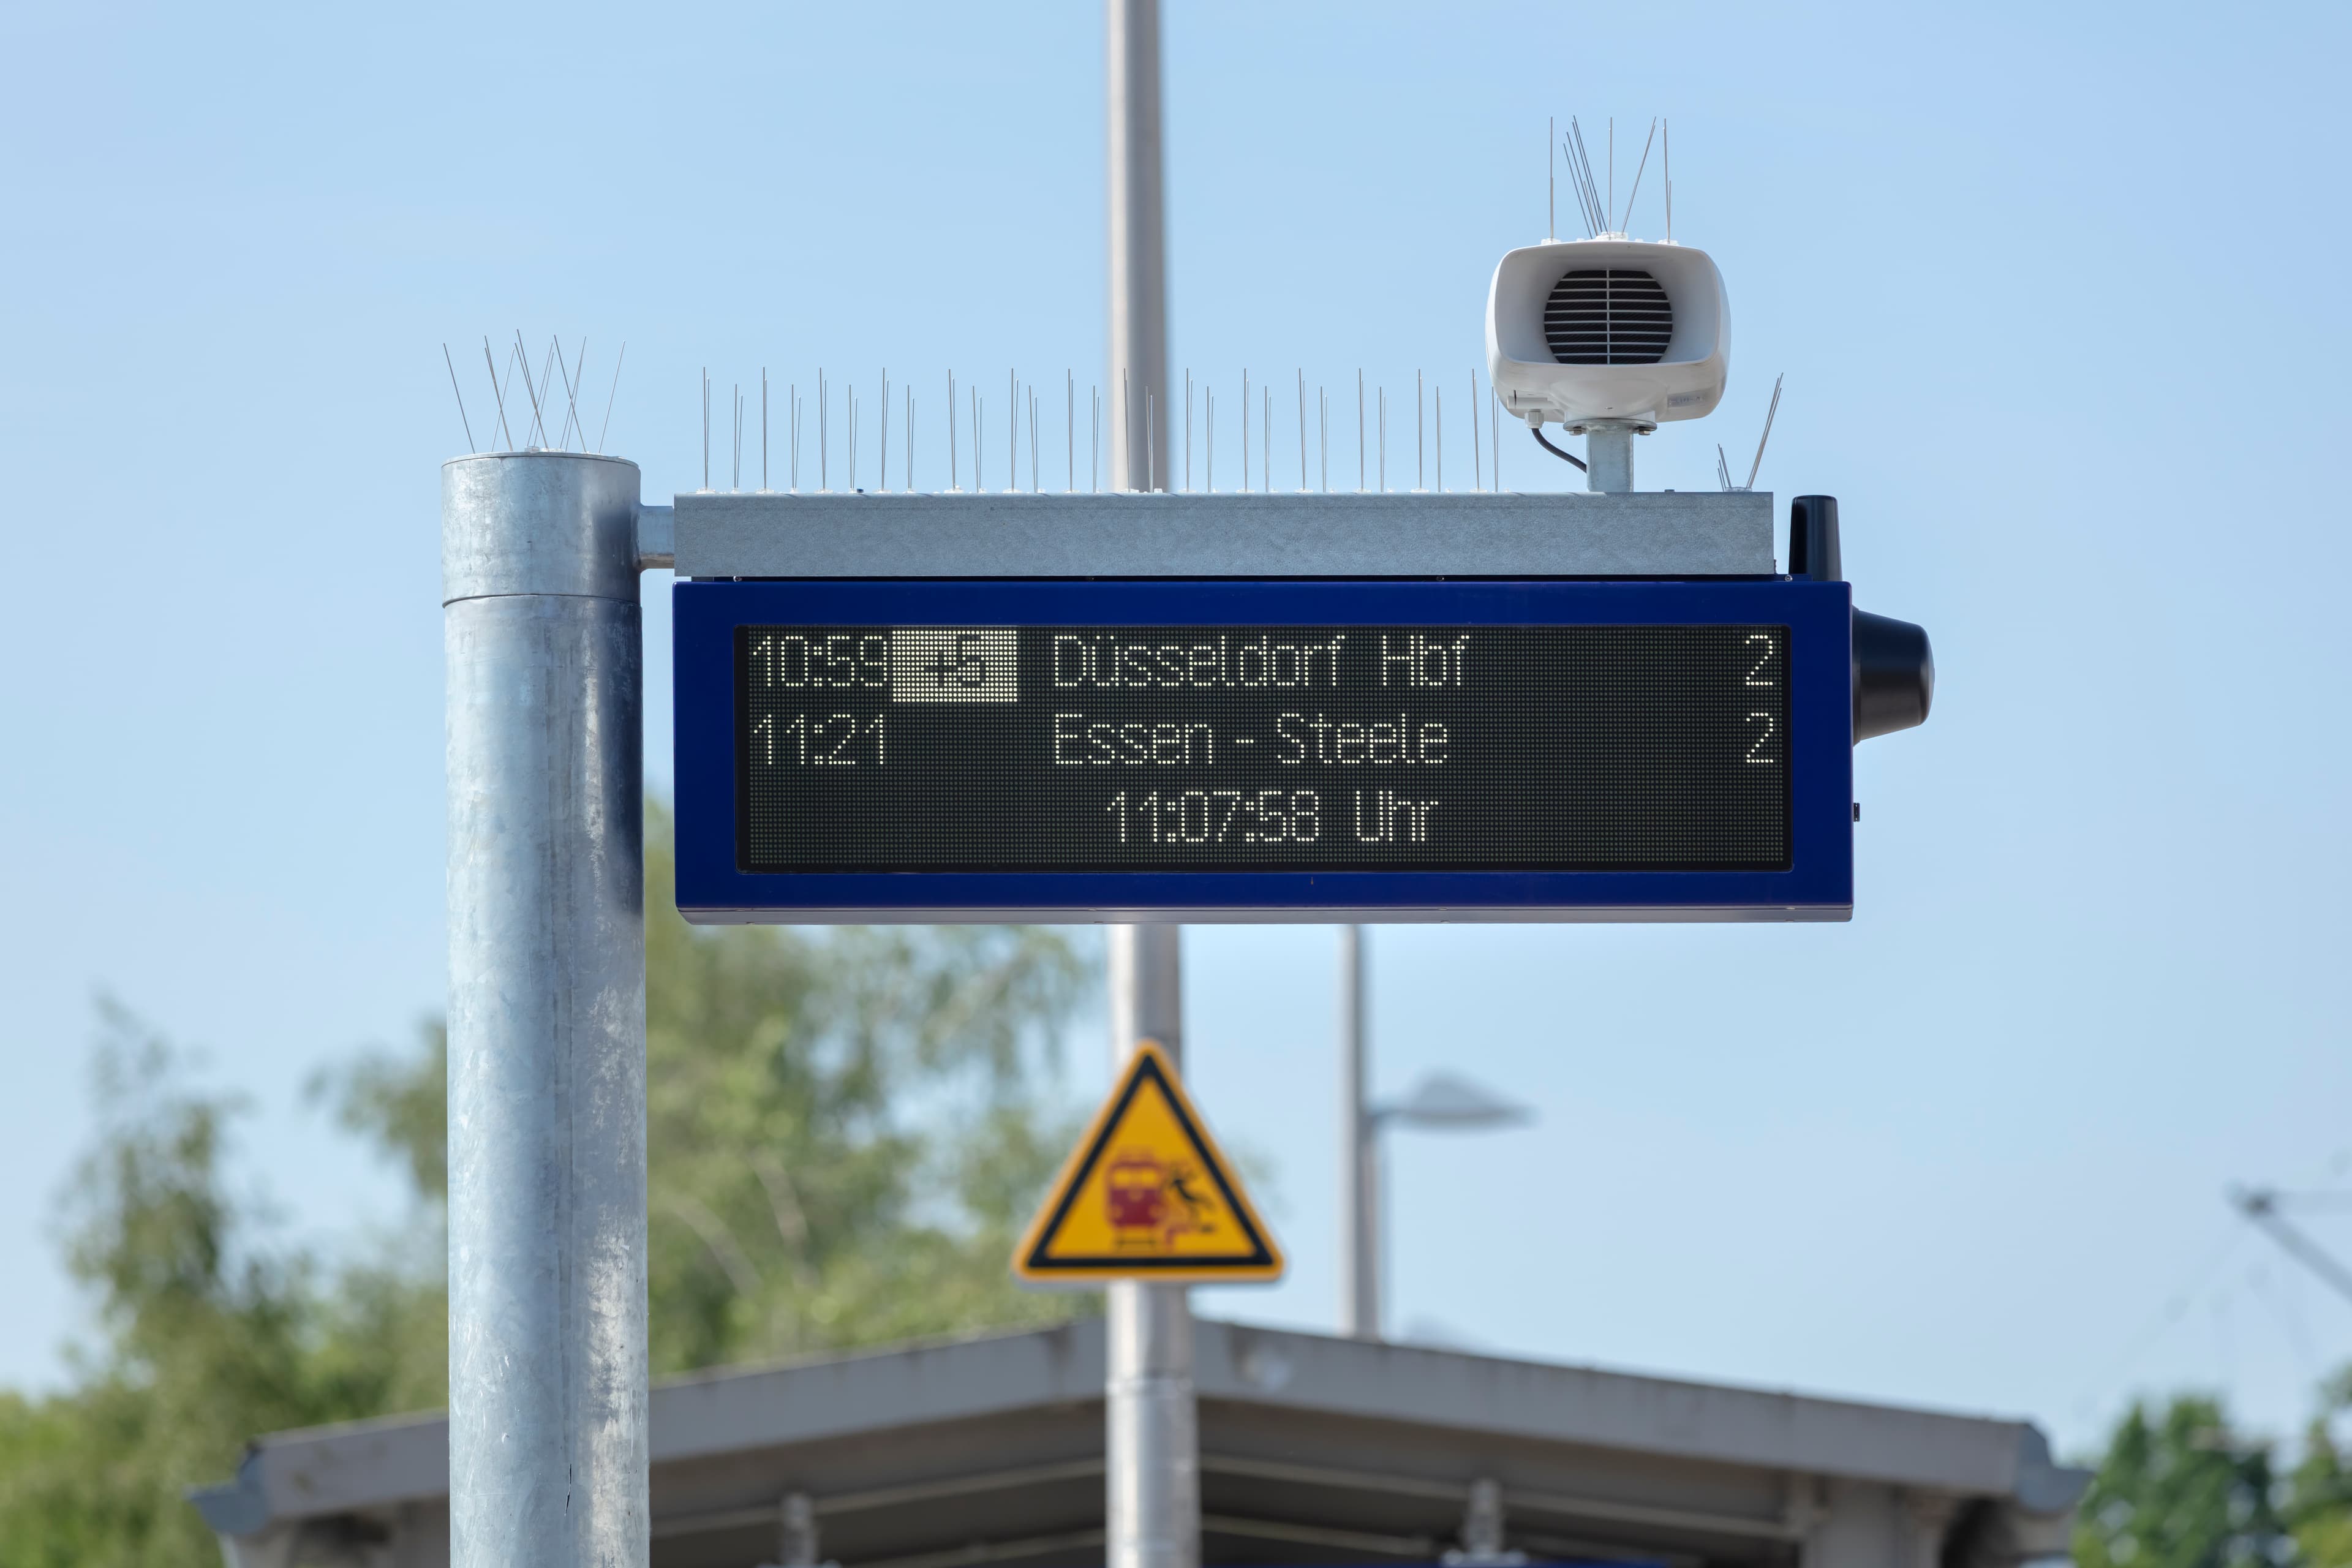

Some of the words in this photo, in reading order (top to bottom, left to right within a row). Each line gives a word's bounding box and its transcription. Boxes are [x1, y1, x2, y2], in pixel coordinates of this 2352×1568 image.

[753, 635, 888, 687] 10:59
[924, 635, 985, 687] +5
[1054, 635, 1346, 687] Düsseldorf
[1382, 635, 1470, 687] Hbf
[1746, 635, 1774, 686] 2
[753, 714, 884, 765] 11:21
[1055, 713, 1213, 765] Essen
[1277, 713, 1448, 764] Steele
[1746, 712, 1774, 764] 2
[1107, 790, 1320, 843] 11:07:58
[1355, 790, 1439, 842] Uhr
